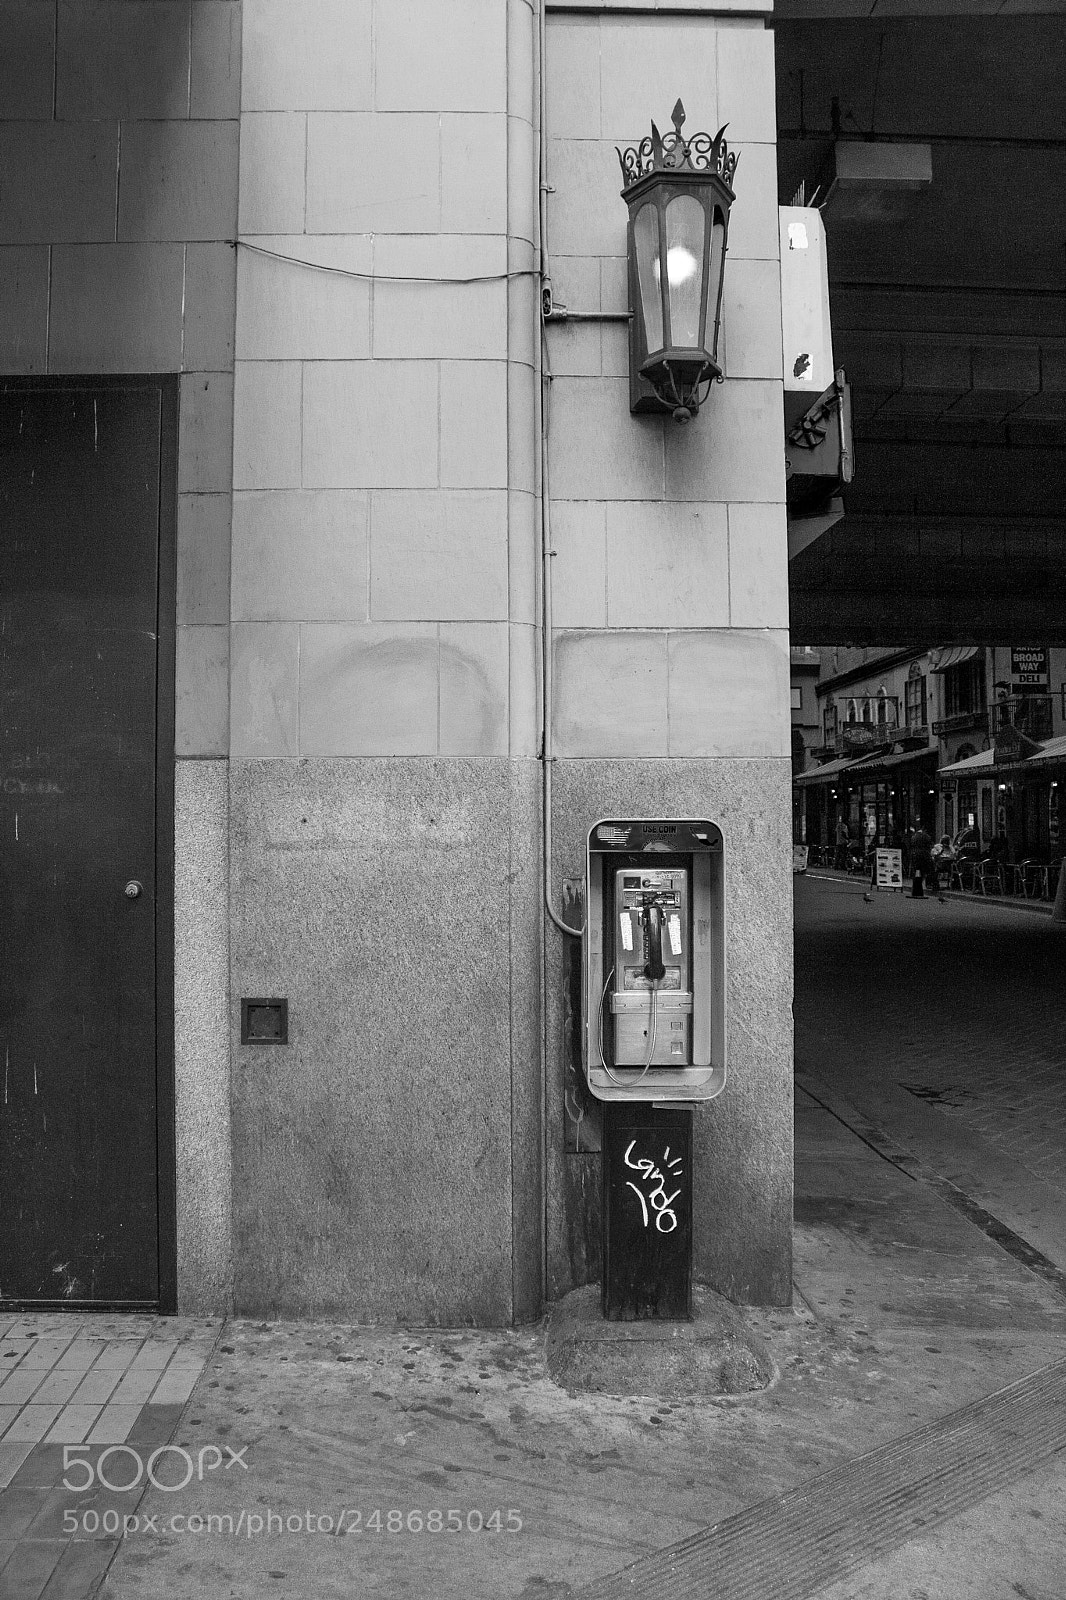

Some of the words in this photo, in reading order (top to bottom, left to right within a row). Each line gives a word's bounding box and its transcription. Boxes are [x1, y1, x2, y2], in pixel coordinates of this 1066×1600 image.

[1013, 654, 1044, 662] BROAD
[1019, 662, 1039, 670] WAY
[1019, 674, 1040, 682] DELI
[642, 825, 657, 833] USE
[658, 825, 677, 834] COIN
